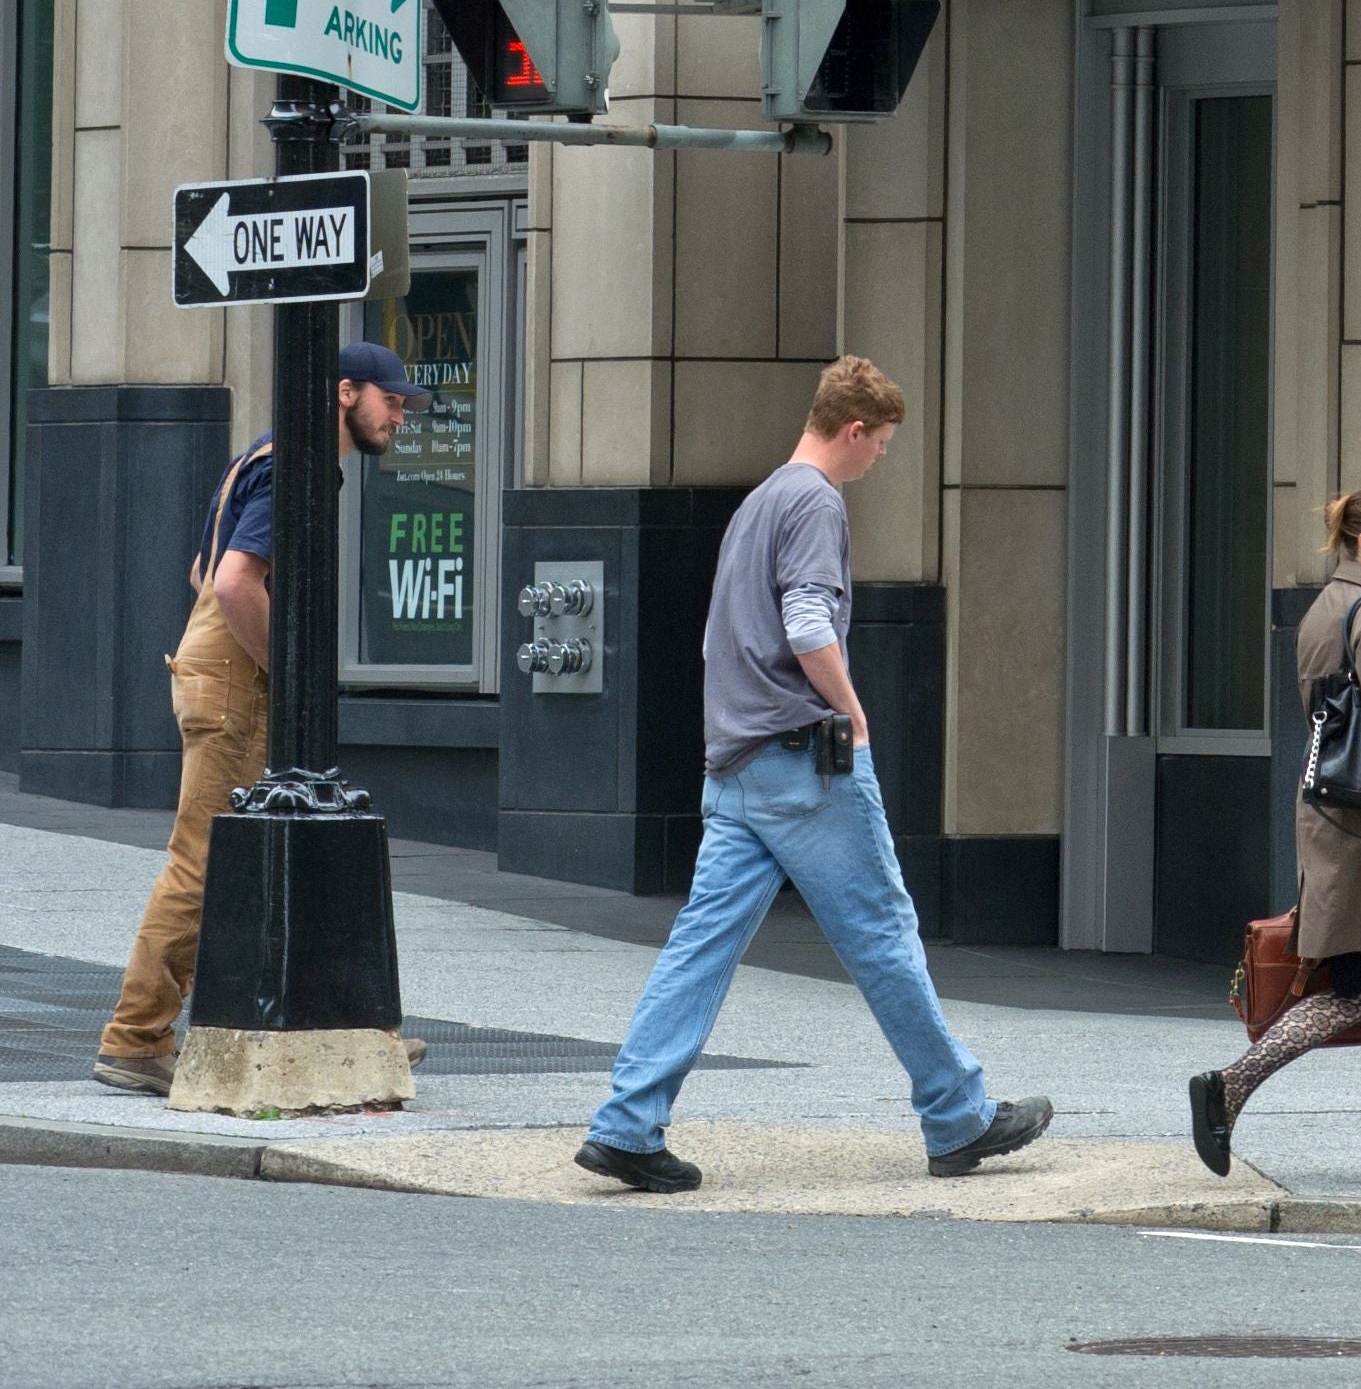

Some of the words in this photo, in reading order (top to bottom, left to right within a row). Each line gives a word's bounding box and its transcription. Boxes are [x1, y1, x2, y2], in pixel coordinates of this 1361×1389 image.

[233, 218, 284, 264] ONE
[295, 213, 347, 260] WAY
[395, 312, 476, 361] OPEN
[403, 363, 440, 386] VERY
[442, 362, 473, 385] DAY
[394, 440, 423, 458] Sunday
[389, 513, 464, 553] FREE
[389, 557, 463, 619] Wi-Fi
